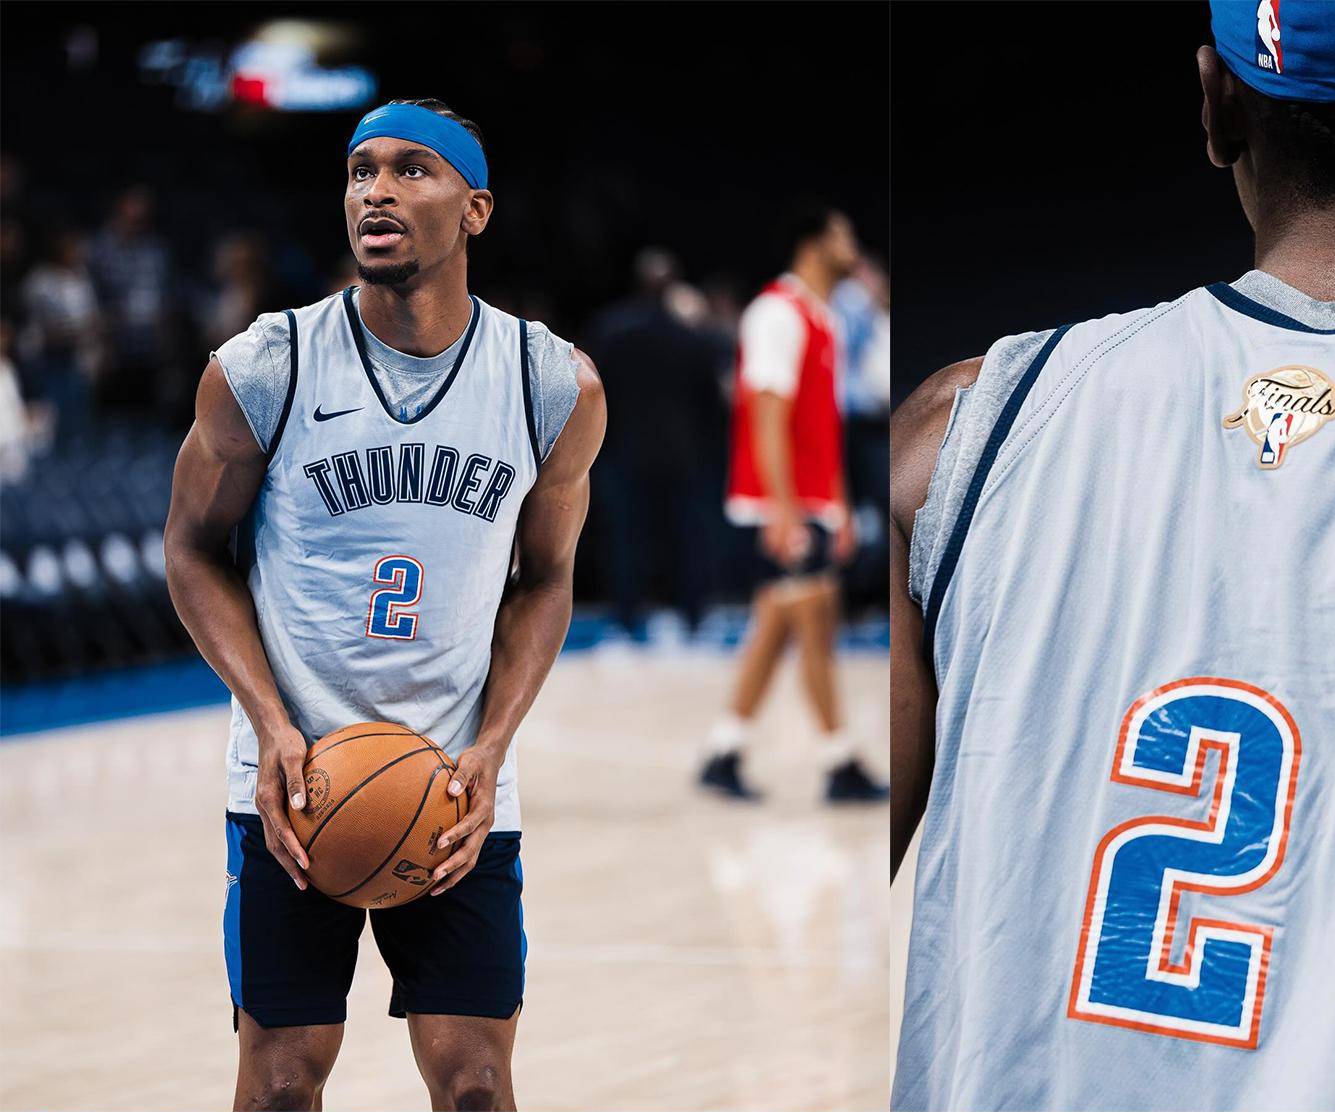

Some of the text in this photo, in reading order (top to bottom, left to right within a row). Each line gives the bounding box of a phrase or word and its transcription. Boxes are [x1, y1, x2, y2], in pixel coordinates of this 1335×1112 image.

[1257, 53, 1273, 69] NBA
[1226, 378, 1335, 423] Finals
[303, 443, 516, 523] THUNDER
[365, 554, 425, 641] 2
[1067, 676, 1302, 1050] 2
